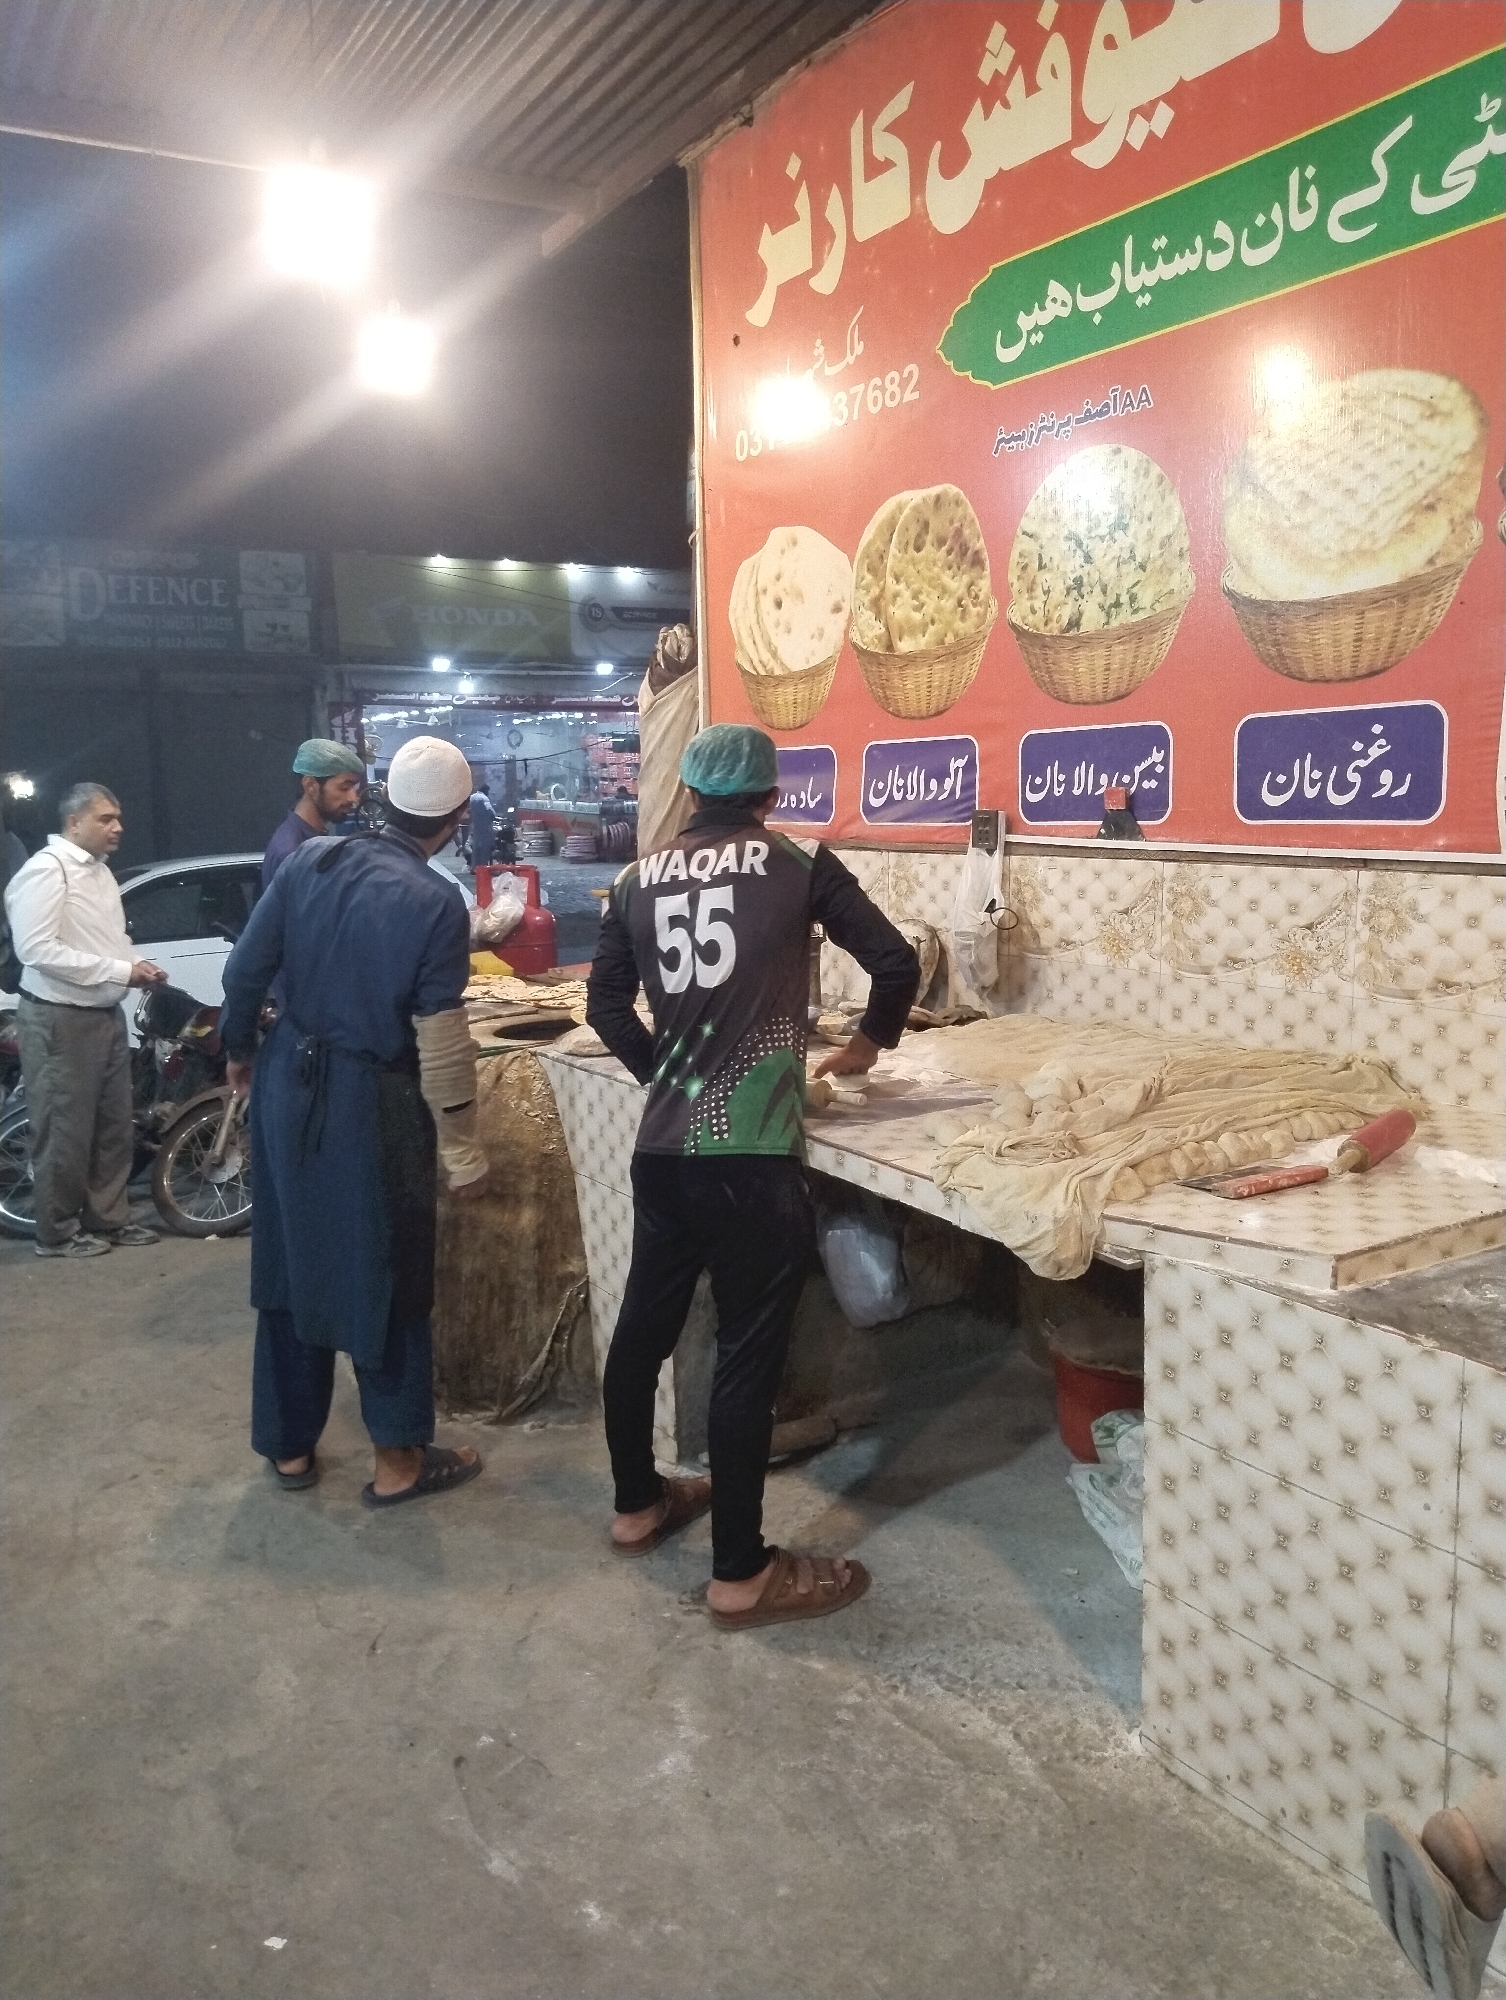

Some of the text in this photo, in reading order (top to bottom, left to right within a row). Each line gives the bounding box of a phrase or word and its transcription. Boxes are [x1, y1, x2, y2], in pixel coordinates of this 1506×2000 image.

[746, 82, 913, 328] کارنر
[1241, 165, 1320, 266] نان
[1328, 115, 1413, 243] کے
[1076, 219, 1235, 325] دستیاب
[824, 305, 865, 376] ملک
[68, 566, 231, 622] DEFENCE
[412, 606, 539, 626] HONDA
[869, 765, 905, 807] نان
[1026, 760, 1066, 803] نان
[1261, 723, 1412, 807] روغنی نان
[640, 840, 769, 889] WAQAR
[655, 884, 736, 994] 55
